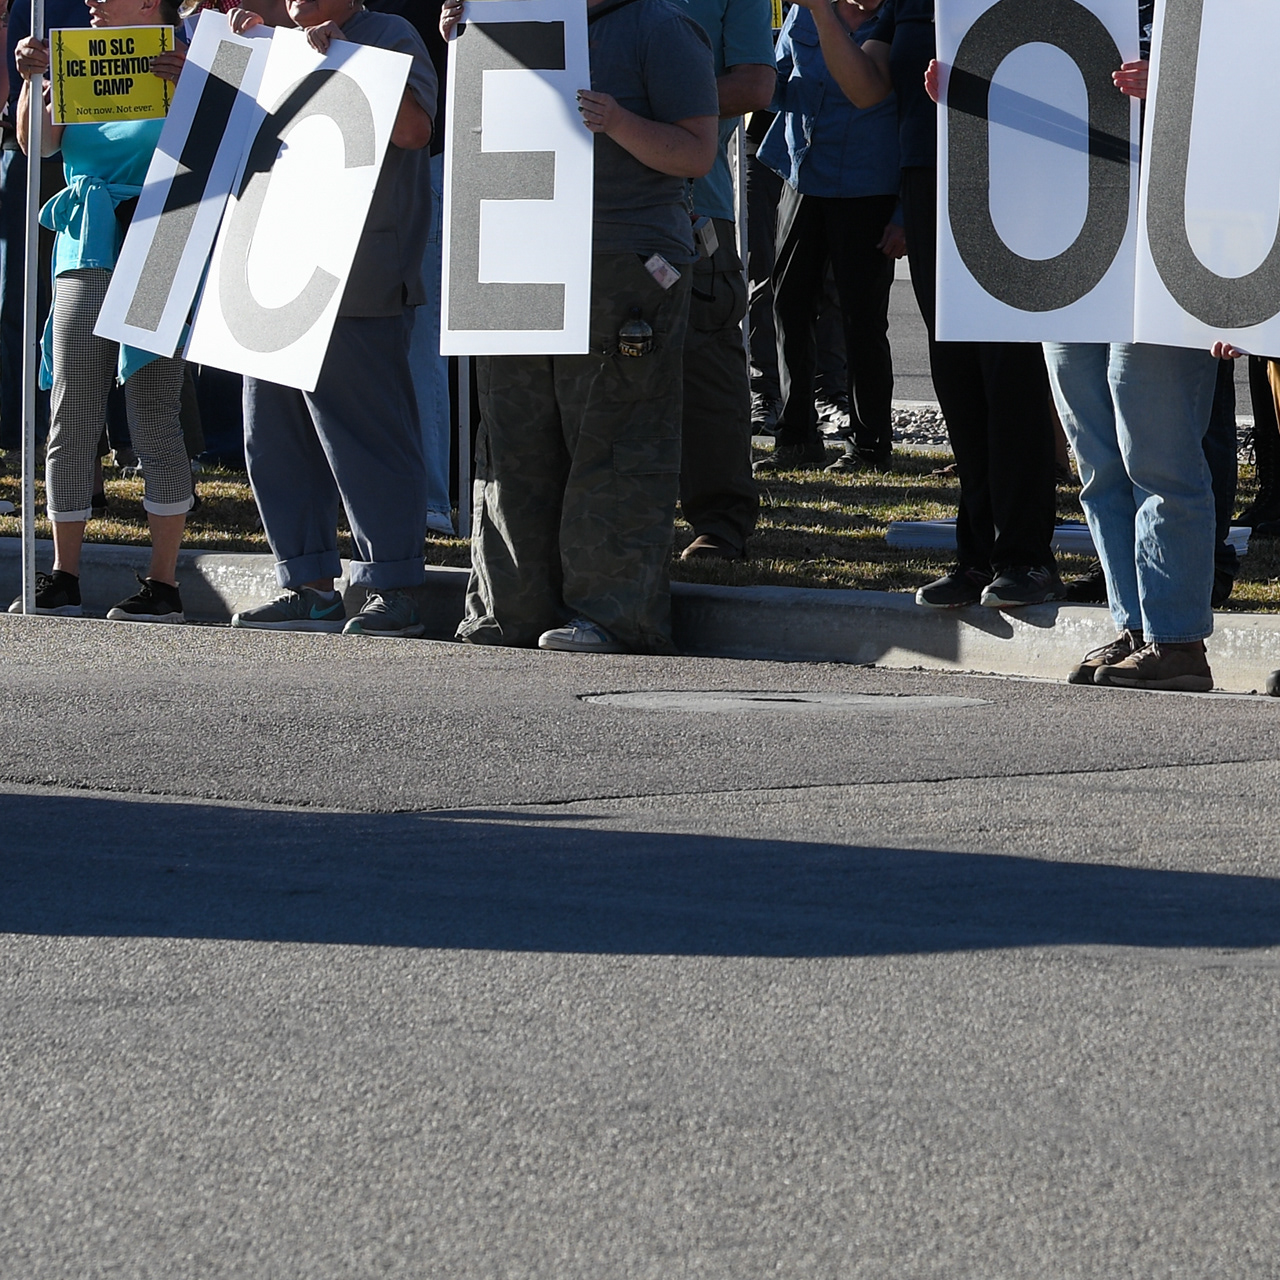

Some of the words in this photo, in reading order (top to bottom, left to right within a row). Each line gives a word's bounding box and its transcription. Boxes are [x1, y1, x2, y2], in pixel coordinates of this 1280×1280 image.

[88, 39, 107, 57] NO
[110, 37, 135, 56] SLC
[66, 59, 87, 78] ICE
[93, 77, 134, 97] CAMP
[76, 107, 93, 116] Not
[94, 106, 115, 115] now.
[116, 104, 133, 114] Not
[133, 104, 155, 113] ever.
